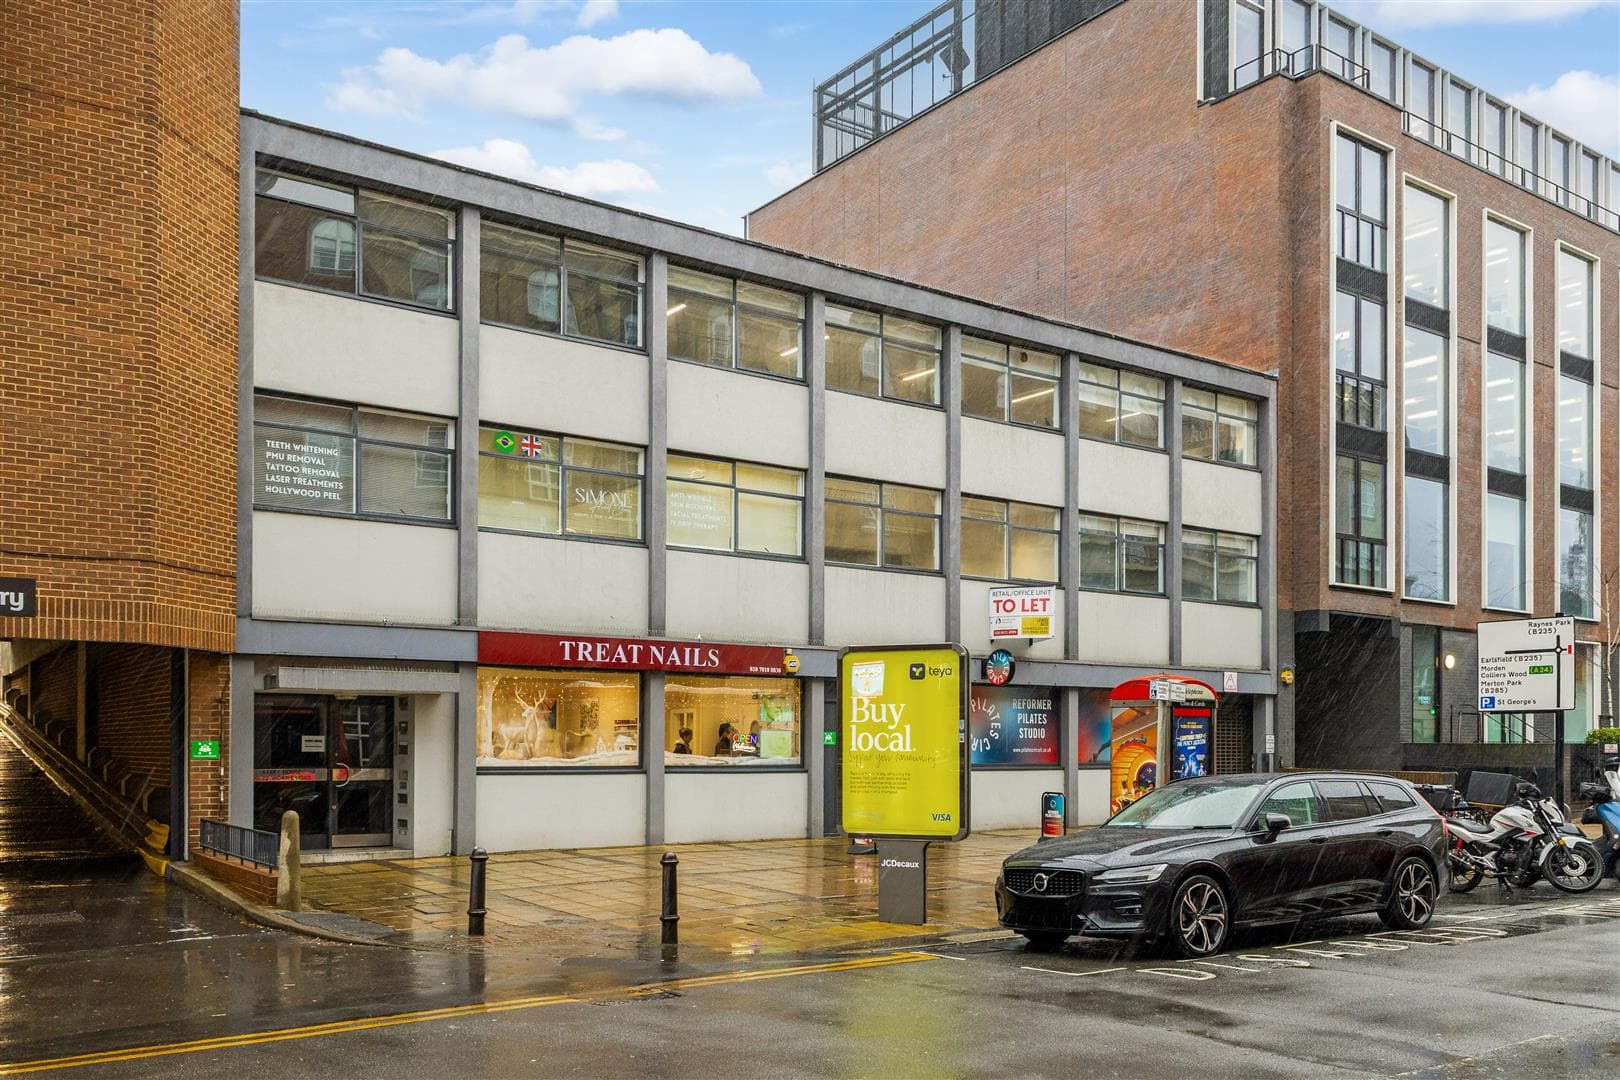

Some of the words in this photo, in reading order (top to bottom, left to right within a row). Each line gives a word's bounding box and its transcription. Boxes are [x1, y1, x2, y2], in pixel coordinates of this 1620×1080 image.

[265, 440, 291, 450] TEETH
[293, 443, 339, 456] WHITENING
[265, 451, 284, 460] PMU
[287, 454, 325, 466] REMOVAL
[265, 462, 300, 473] TATTOO
[302, 466, 340, 478] REMOVAL
[265, 474, 291, 484] LASER
[293, 477, 344, 490] TREATMENTS
[265, 485, 321, 498] HOLLYWOOD
[323, 492, 342, 501] PEEL
[992, 589, 1035, 597] RETAIL/OFFICE
[1036, 588, 1051, 596] UNIT
[993, 599, 1016, 613] TO
[1021, 598, 1051, 612] LET
[1528, 627, 1557, 635] (B235)
[560, 640, 644, 664] TREAT
[649, 645, 720, 667] NAILS
[928, 666, 953, 677] teya
[1012, 699, 1052, 710] REFORMER
[1507, 698, 1537, 706] George's
[850, 696, 906, 730] Buy
[971, 697, 1001, 740] PILATES
[1017, 713, 1048, 724] PILATES
[733, 733, 758, 744] OPEN
[850, 724, 917, 752] local.
[1019, 727, 1046, 739] STUDIO
[932, 813, 952, 822] VISA
[881, 859, 920, 869] JCDecaux
